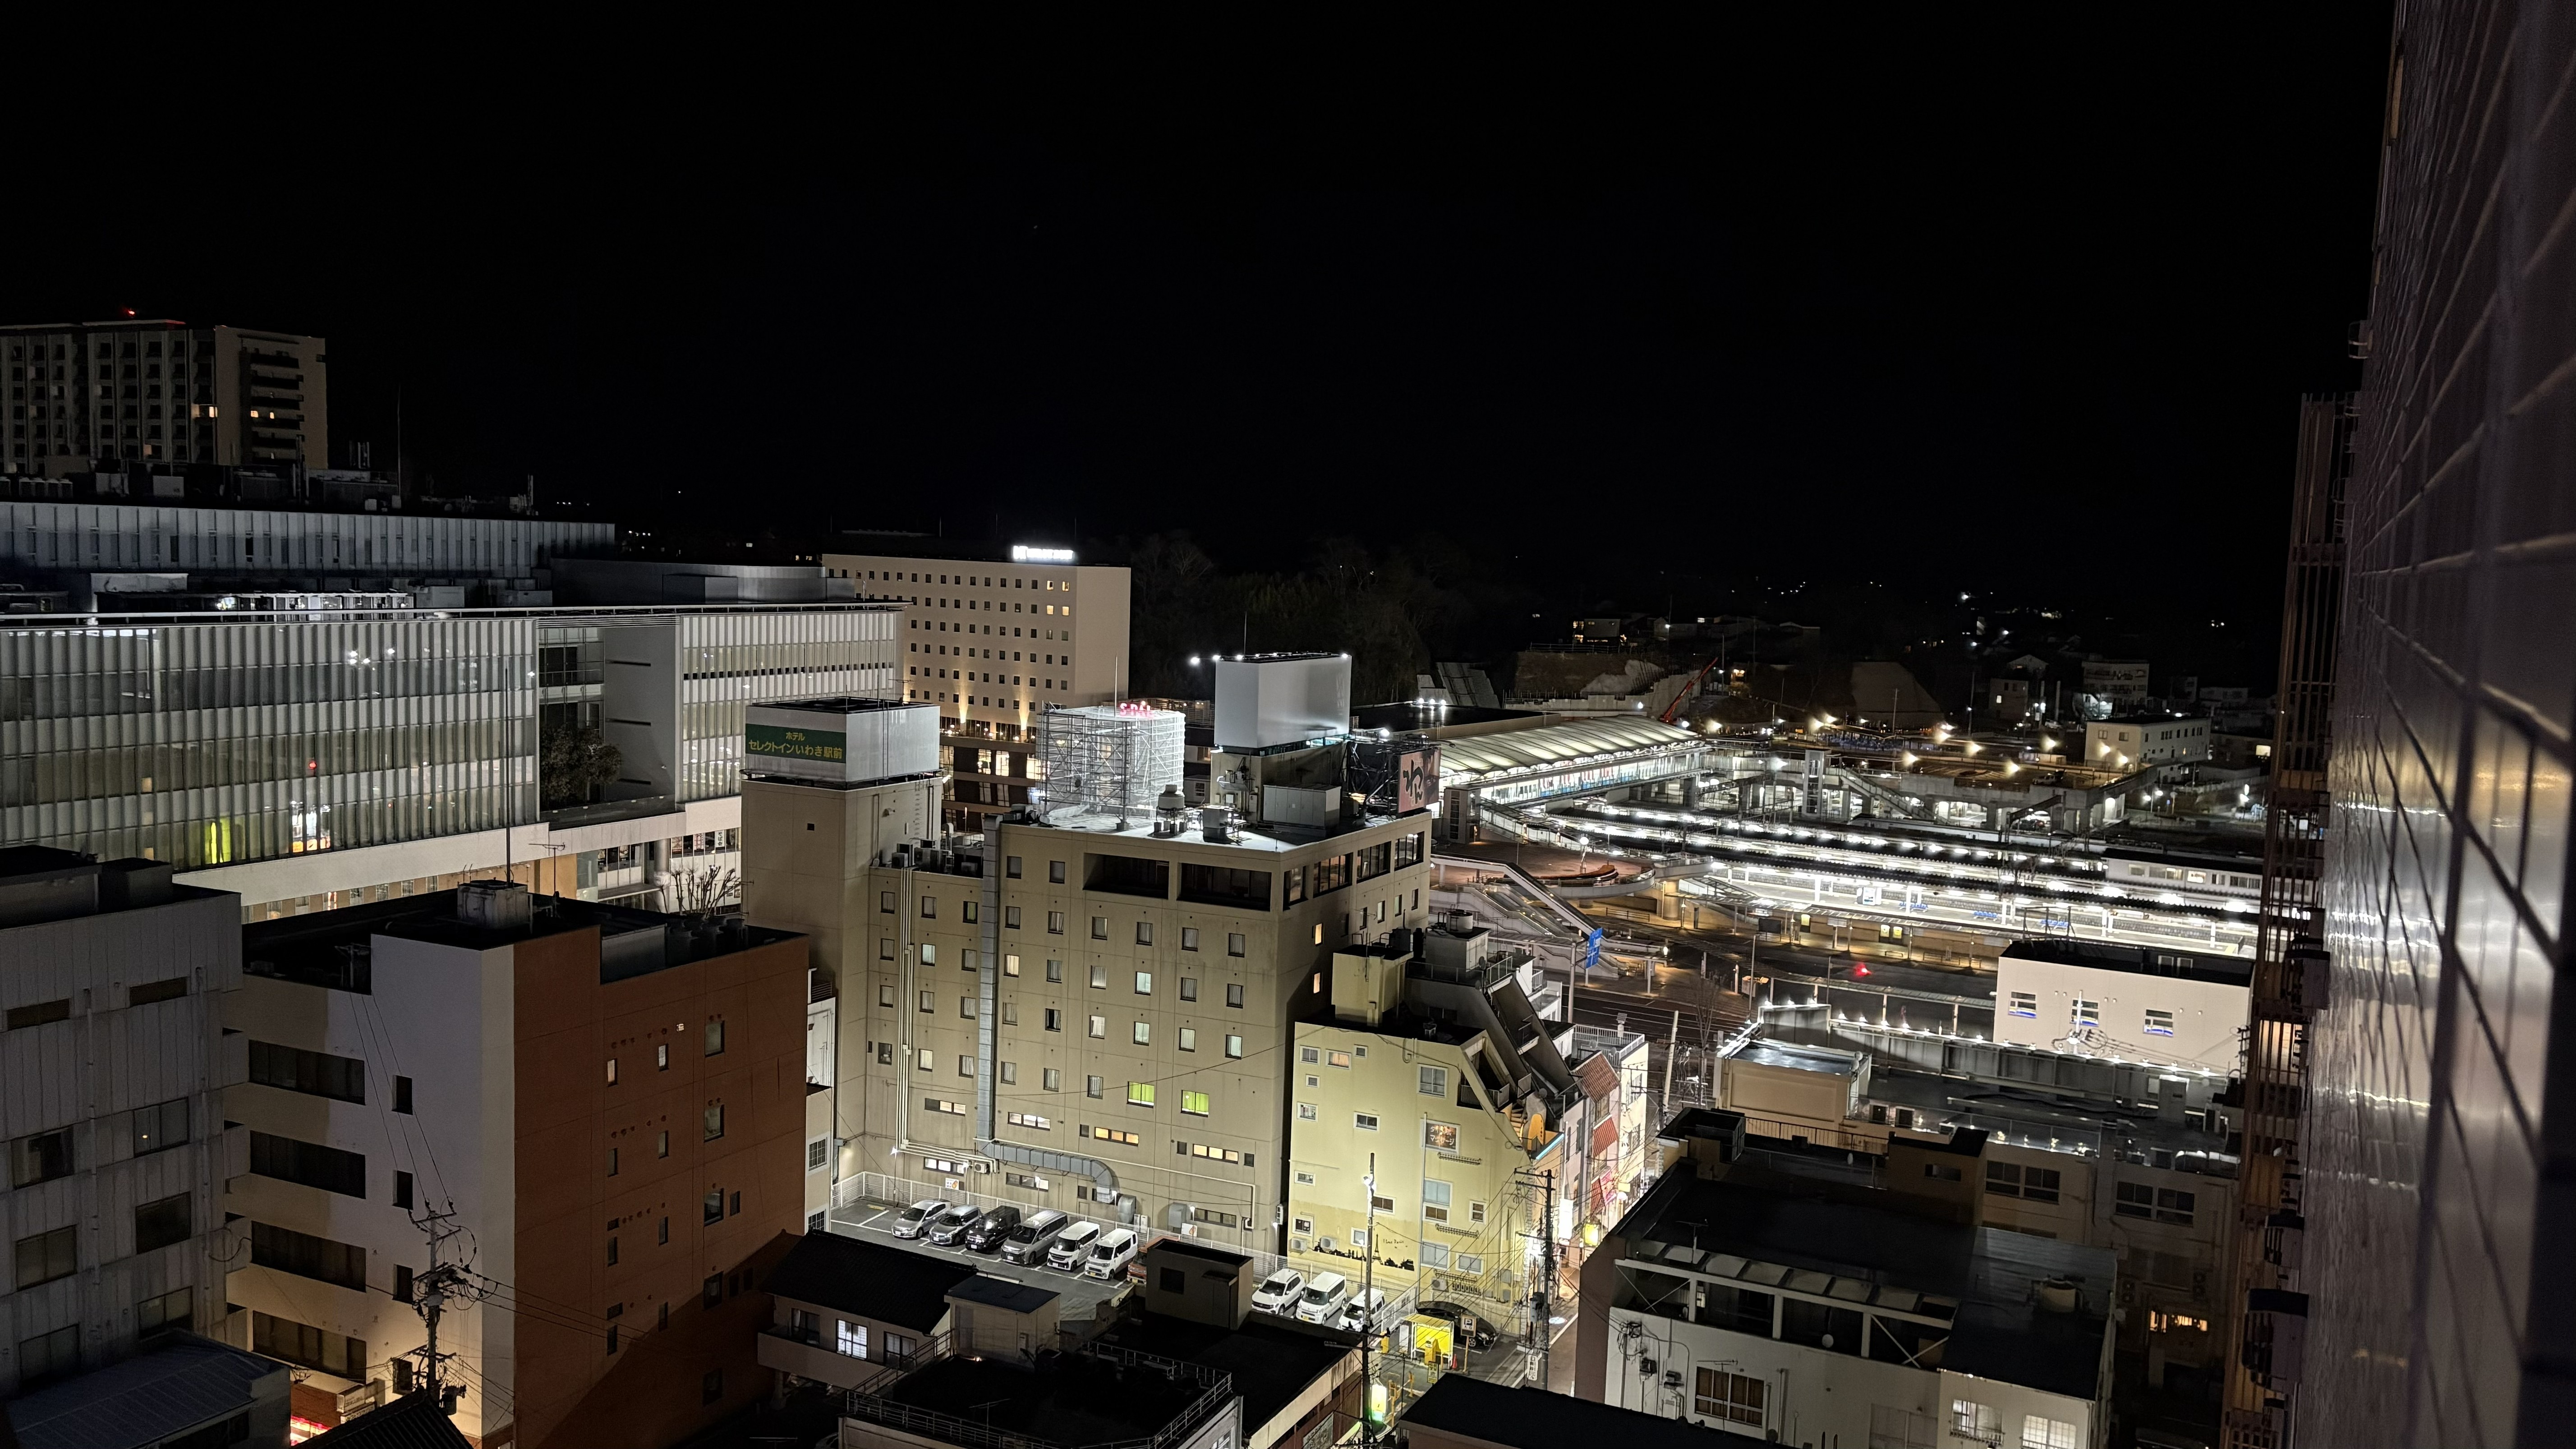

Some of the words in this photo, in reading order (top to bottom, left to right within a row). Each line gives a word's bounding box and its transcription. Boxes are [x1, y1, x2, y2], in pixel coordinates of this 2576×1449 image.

[786, 731, 805, 741] ホテル
[749, 740, 842, 759] セレクトインいわき駅前
